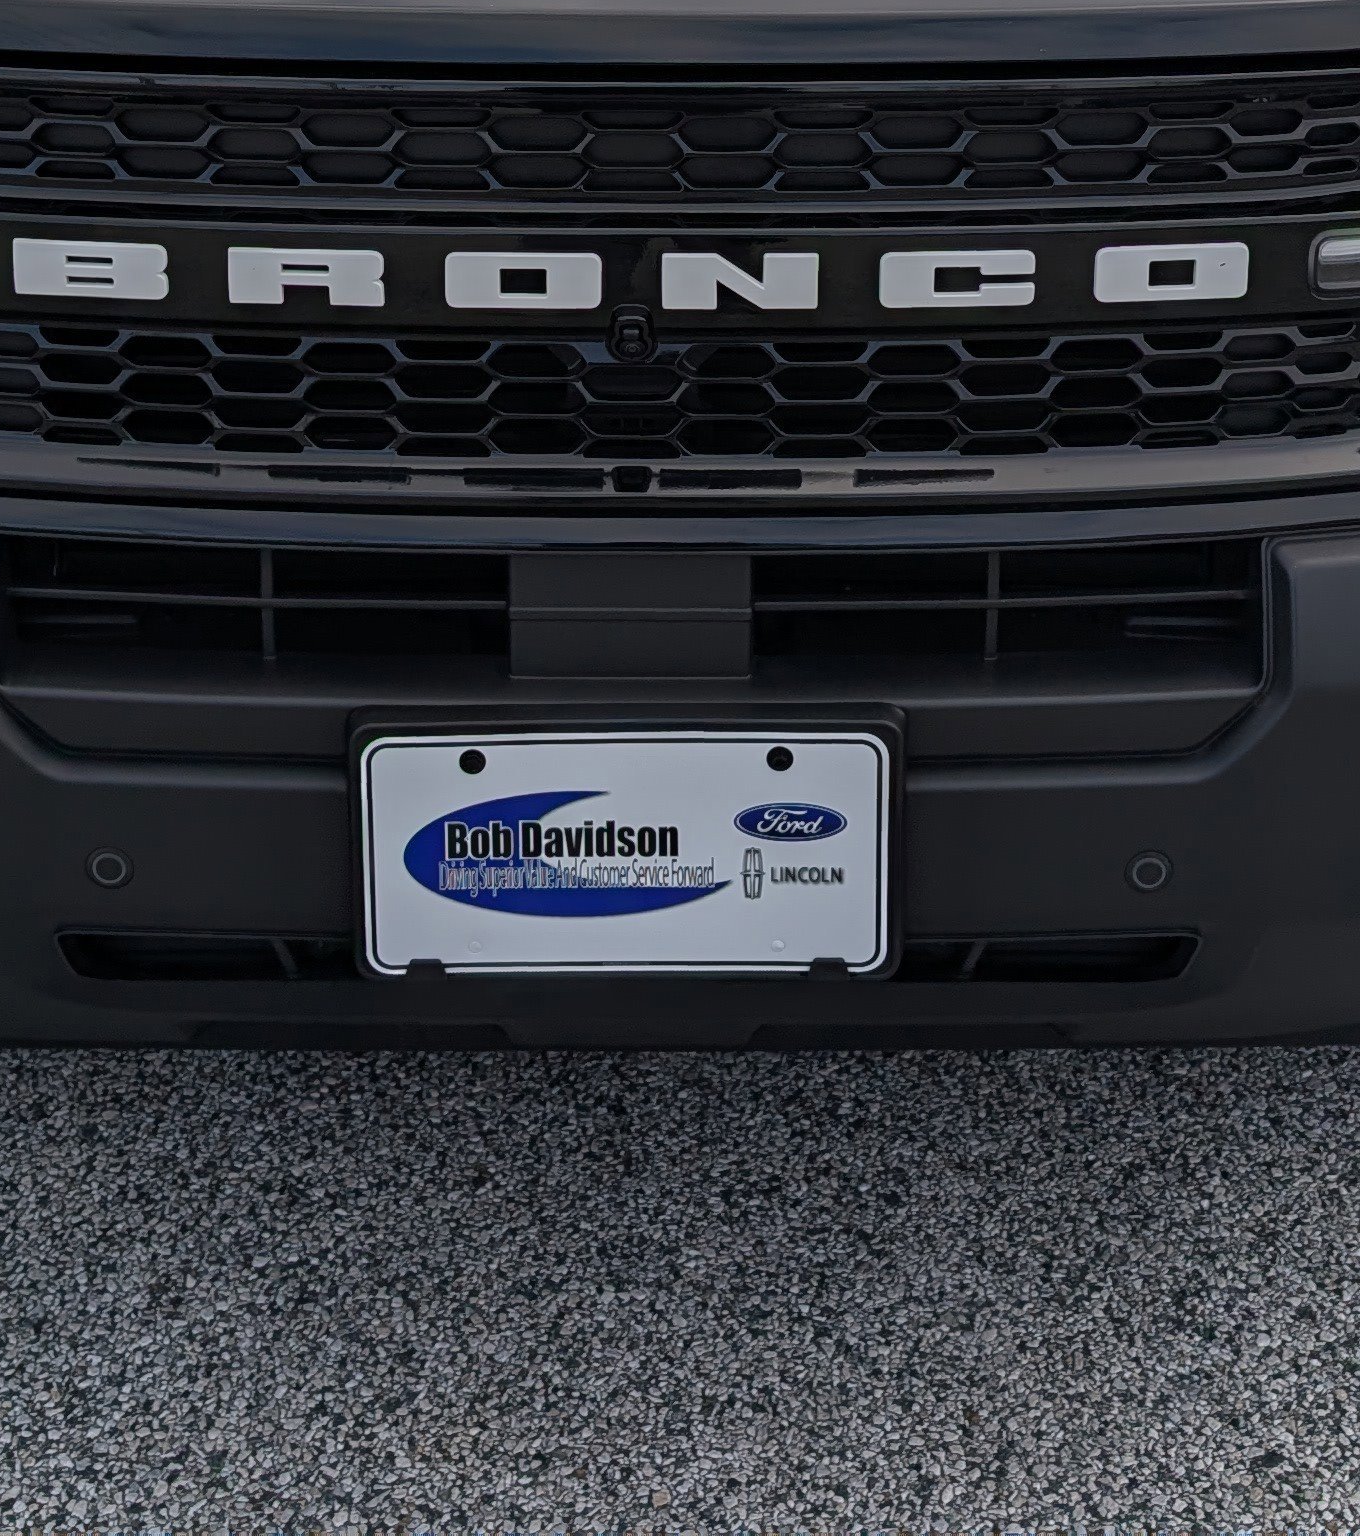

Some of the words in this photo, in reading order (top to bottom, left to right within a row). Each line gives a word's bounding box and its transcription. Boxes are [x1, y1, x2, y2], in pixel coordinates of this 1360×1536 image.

[12, 237, 1249, 311] BRONCO
[445, 821, 513, 860] Bob
[519, 820, 680, 859] Davidson
[756, 808, 824, 834] Ford
[439, 861, 478, 897] Driving
[480, 860, 523, 897] Superior
[523, 859, 554, 889] Value
[554, 858, 578, 888] And
[579, 858, 631, 888] Customer
[632, 858, 669, 887] Service
[671, 856, 716, 887] Forward
[770, 866, 846, 884] LINCOLN
